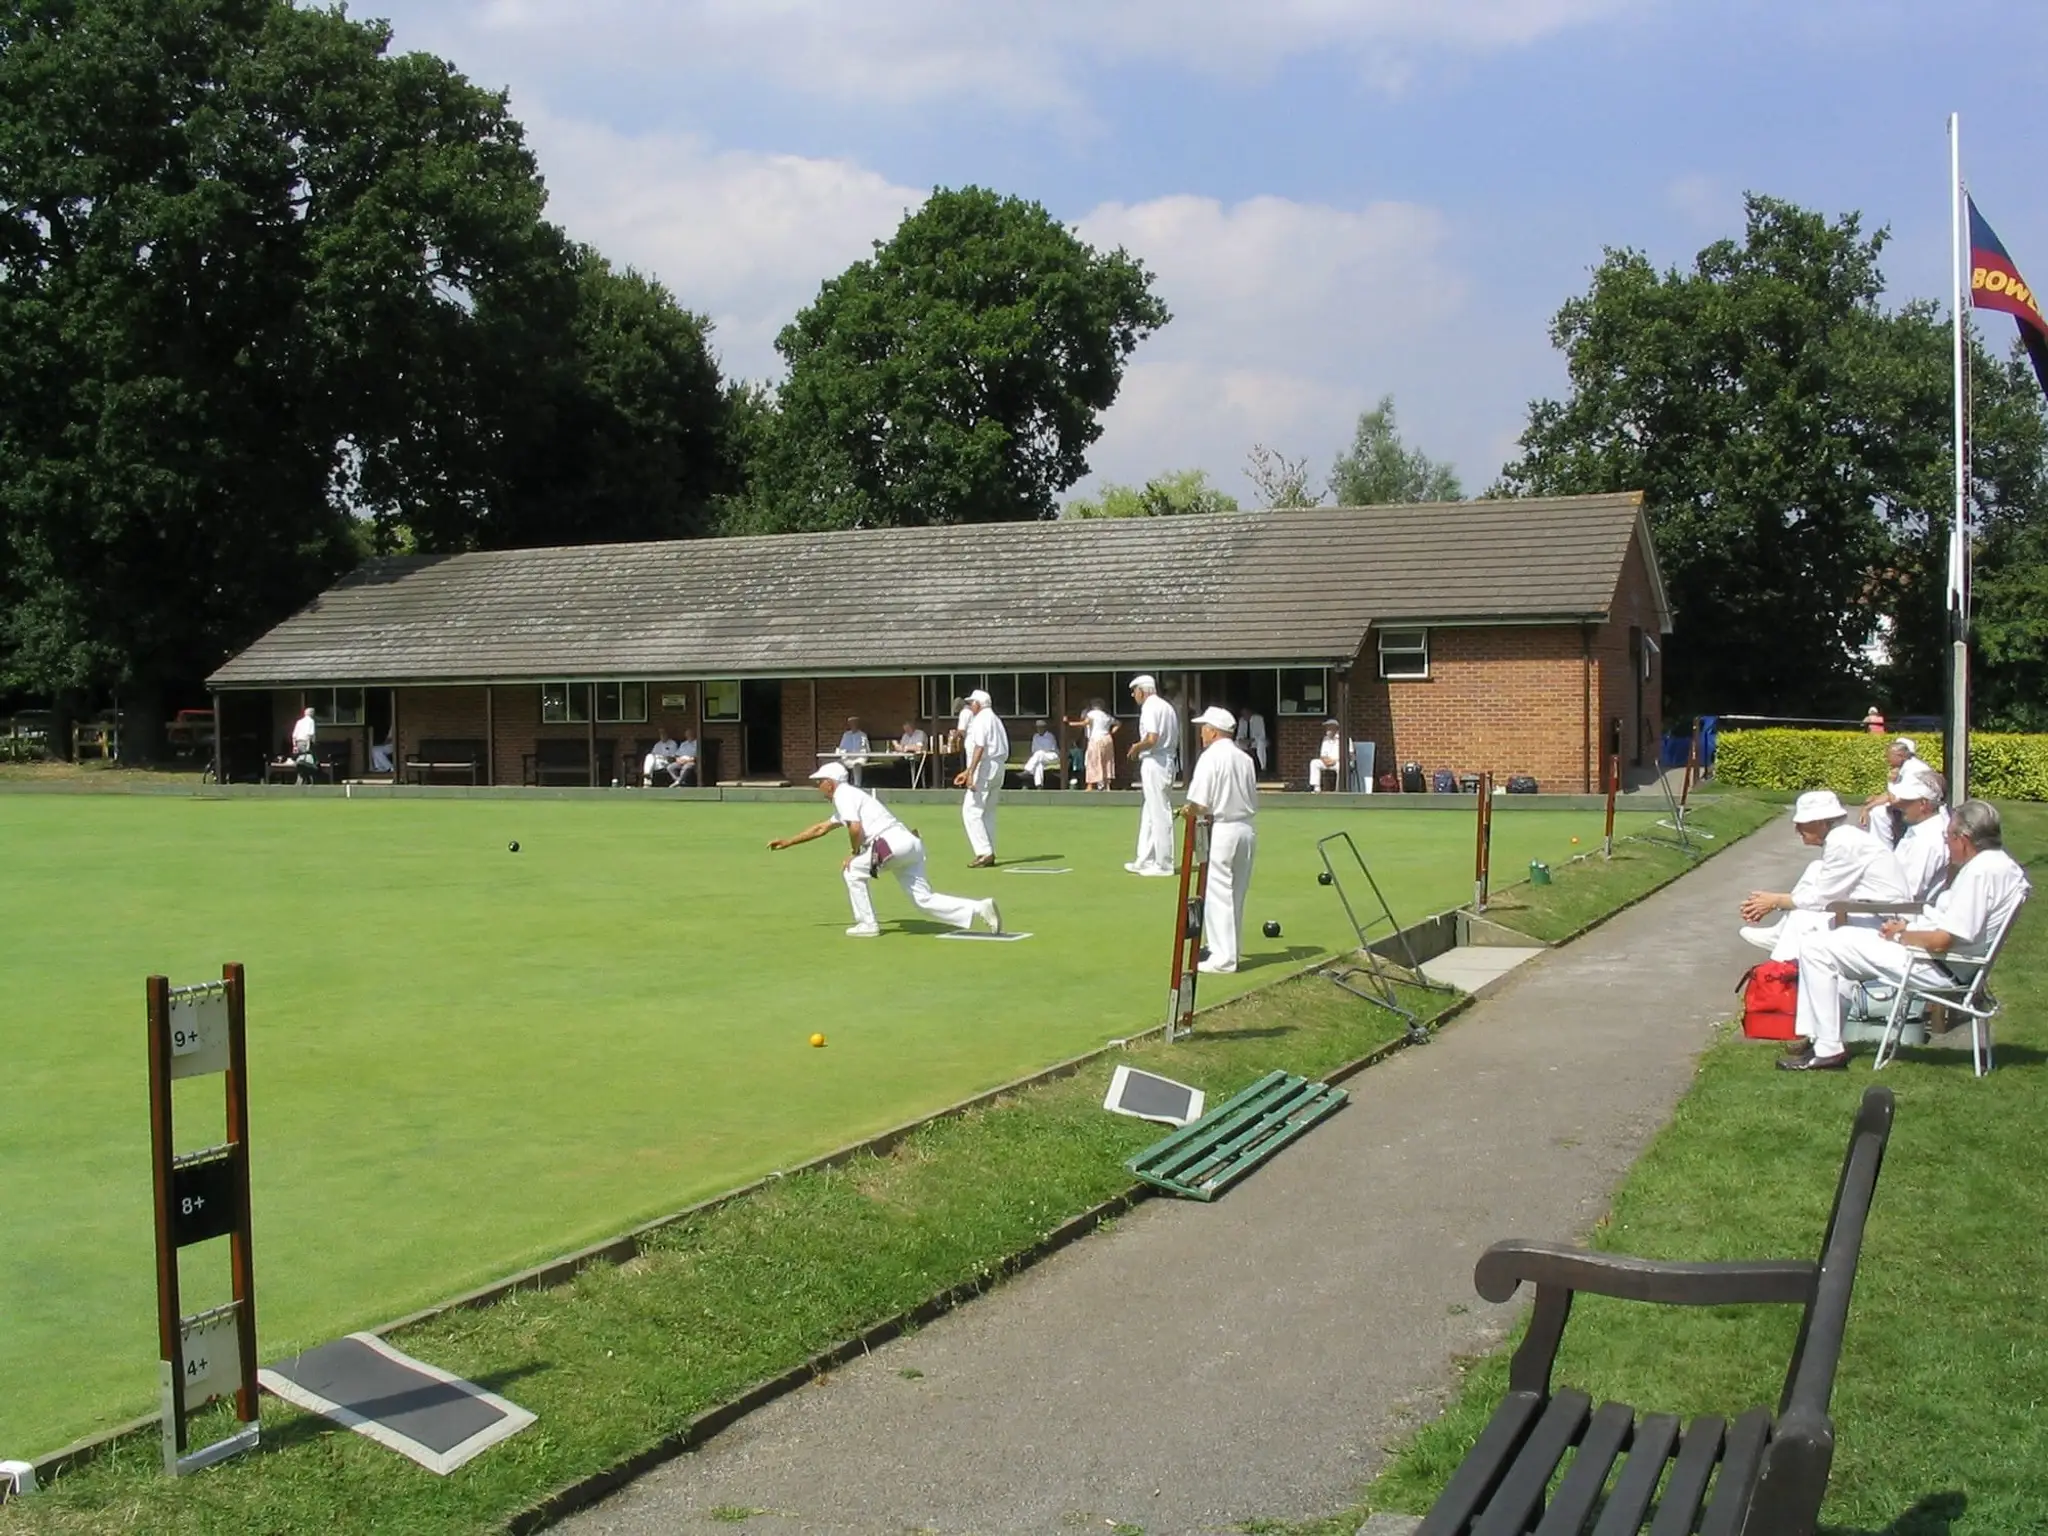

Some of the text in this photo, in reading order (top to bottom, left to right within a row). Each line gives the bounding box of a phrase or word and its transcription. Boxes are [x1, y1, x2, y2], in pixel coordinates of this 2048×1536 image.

[174, 1031, 198, 1047] 9+
[182, 1196, 205, 1214] 8+
[187, 1358, 208, 1375] 4+
